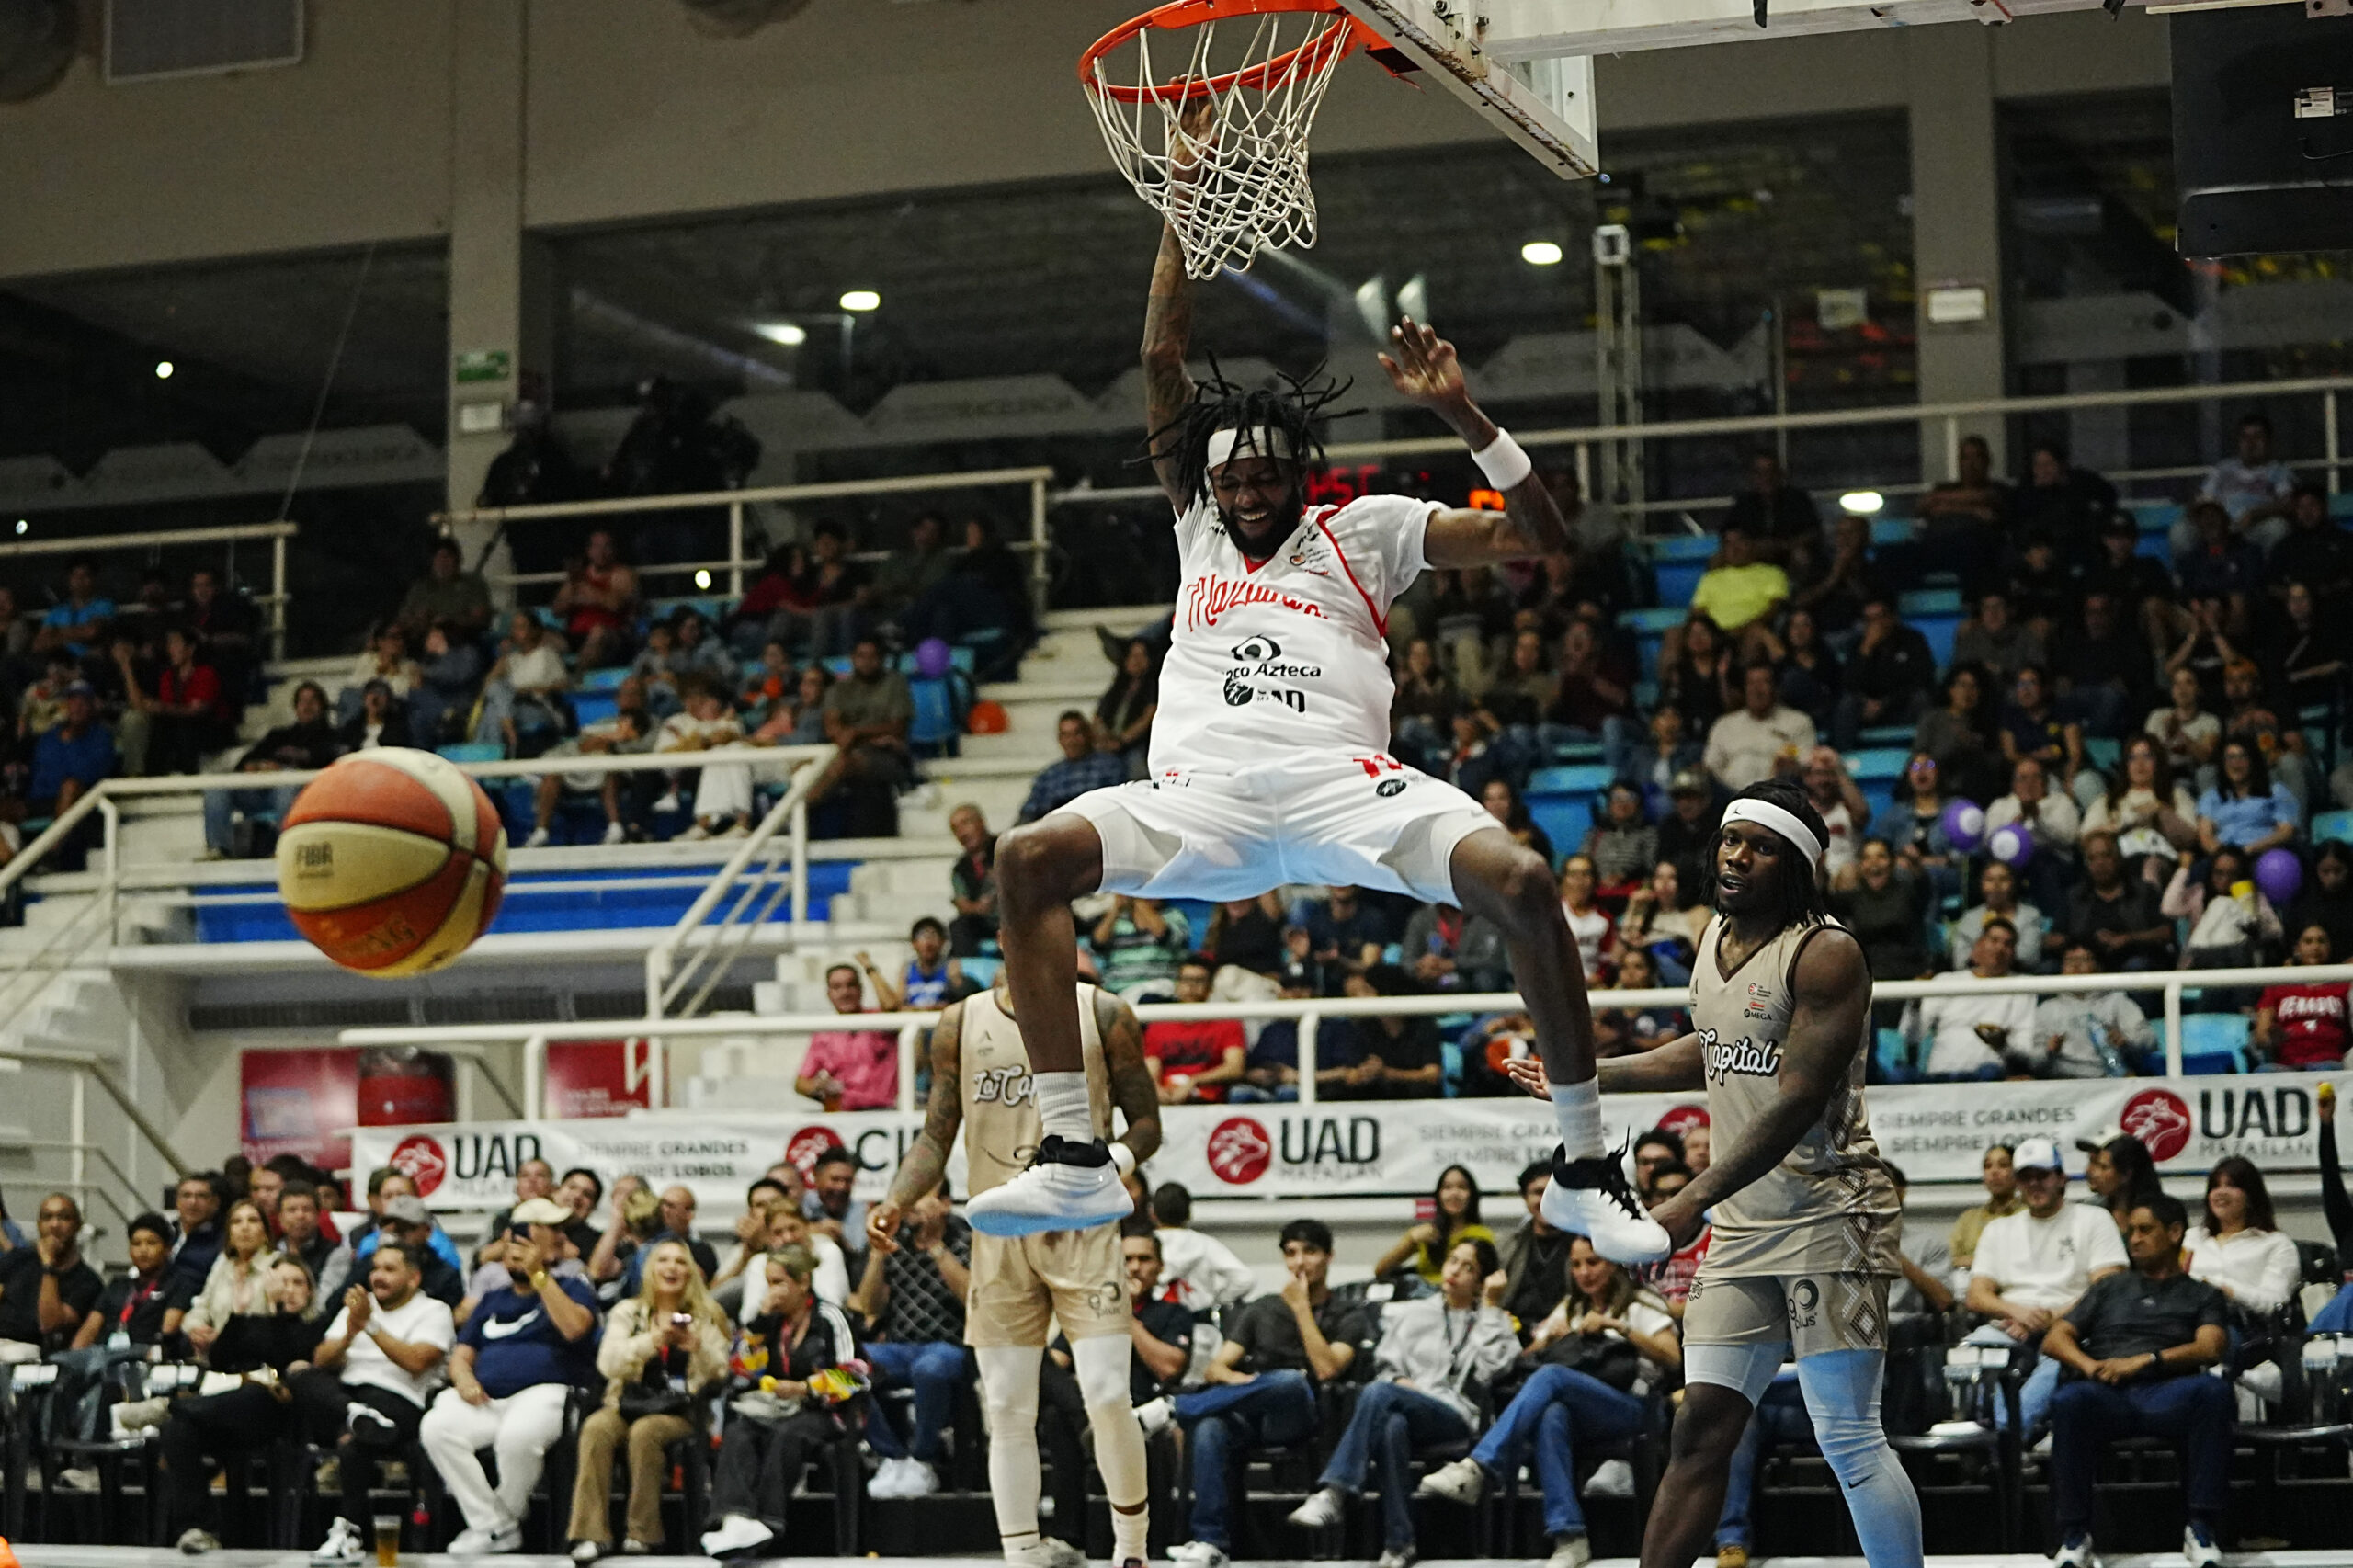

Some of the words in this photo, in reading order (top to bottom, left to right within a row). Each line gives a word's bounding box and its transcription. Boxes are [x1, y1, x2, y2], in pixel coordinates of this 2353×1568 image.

[1254, 663, 1322, 677] Azteca
[1751, 1012, 1772, 1021] MEGA
[1698, 1028, 1779, 1086] Capital
[1877, 1110, 1967, 1128] SIEMPRE
[1973, 1107, 2076, 1126] GRANDES
[2200, 1086, 2311, 1139] UAD
[1280, 1116, 1381, 1165] UAD
[1420, 1124, 1506, 1140] SIEMPRE
[658, 1139, 749, 1155] GRANDES
[1891, 1133, 1984, 1152] SIEMPRE
[1433, 1148, 1518, 1165] SIEMPRE
